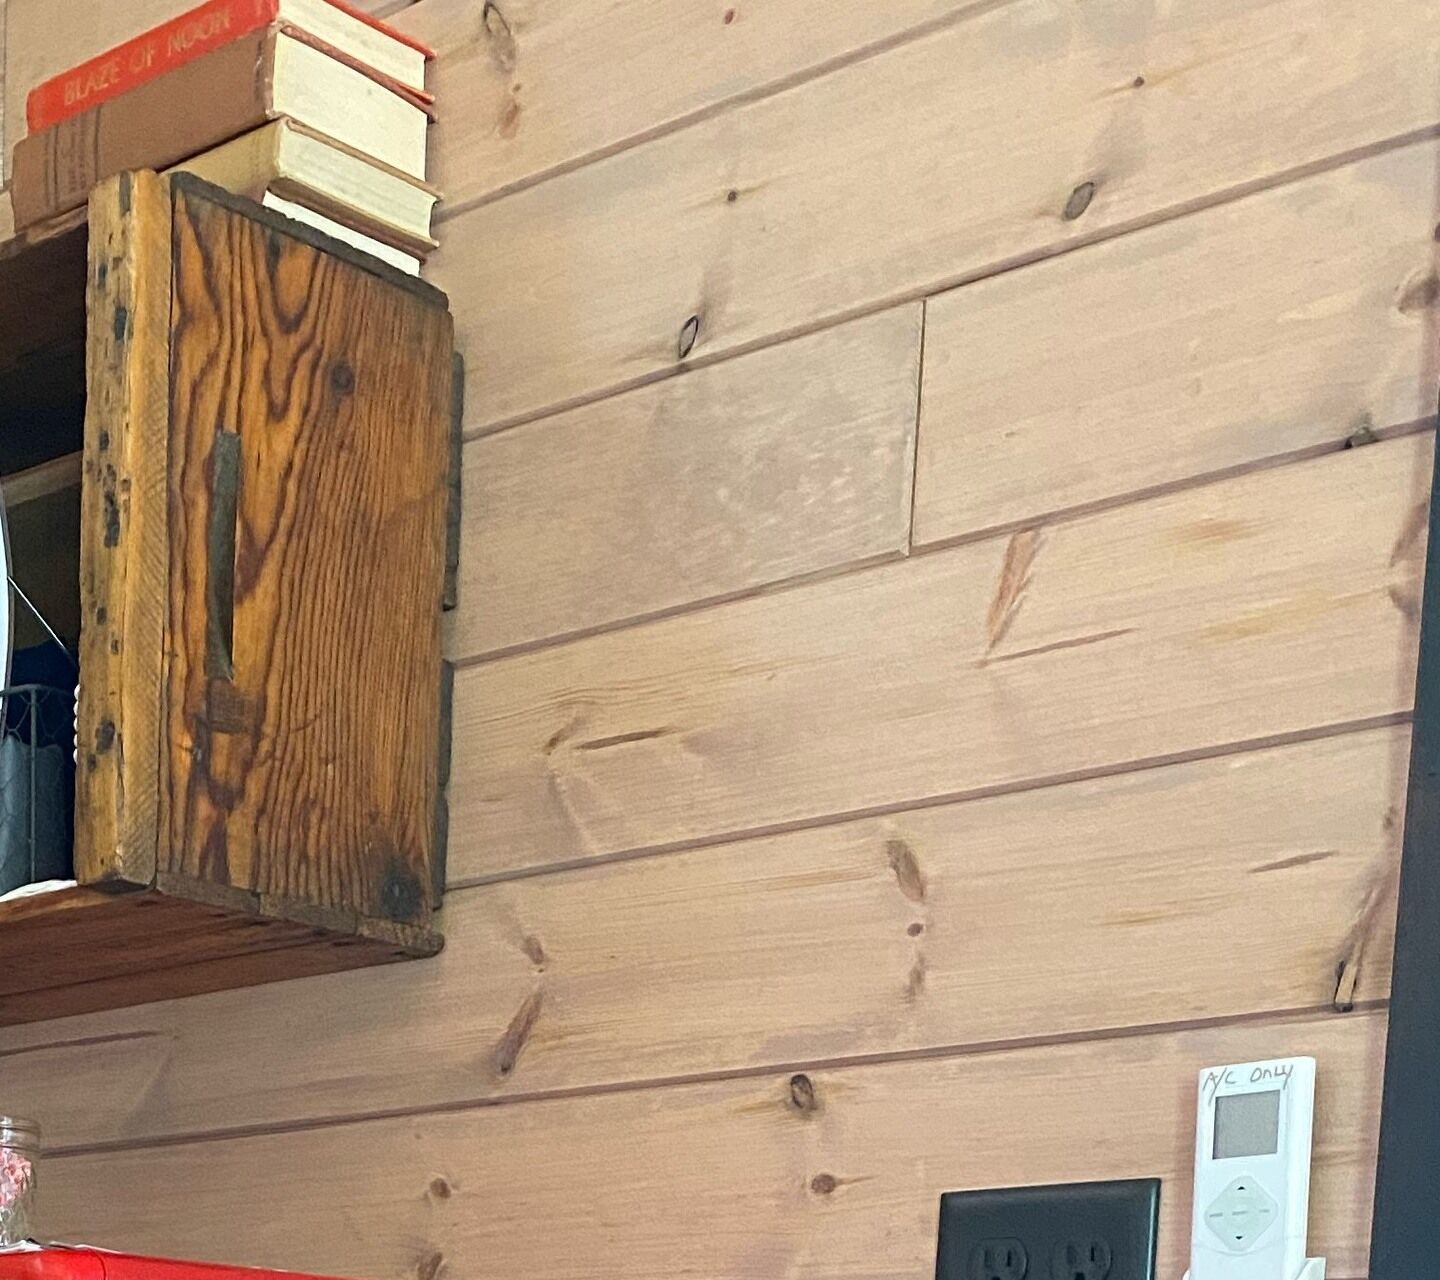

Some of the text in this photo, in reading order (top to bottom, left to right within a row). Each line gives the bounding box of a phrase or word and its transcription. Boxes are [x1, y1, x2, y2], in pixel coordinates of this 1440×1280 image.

[64, 8, 231, 106] BLAZE OF NOON
[1202, 1066, 1237, 1107] A/C
